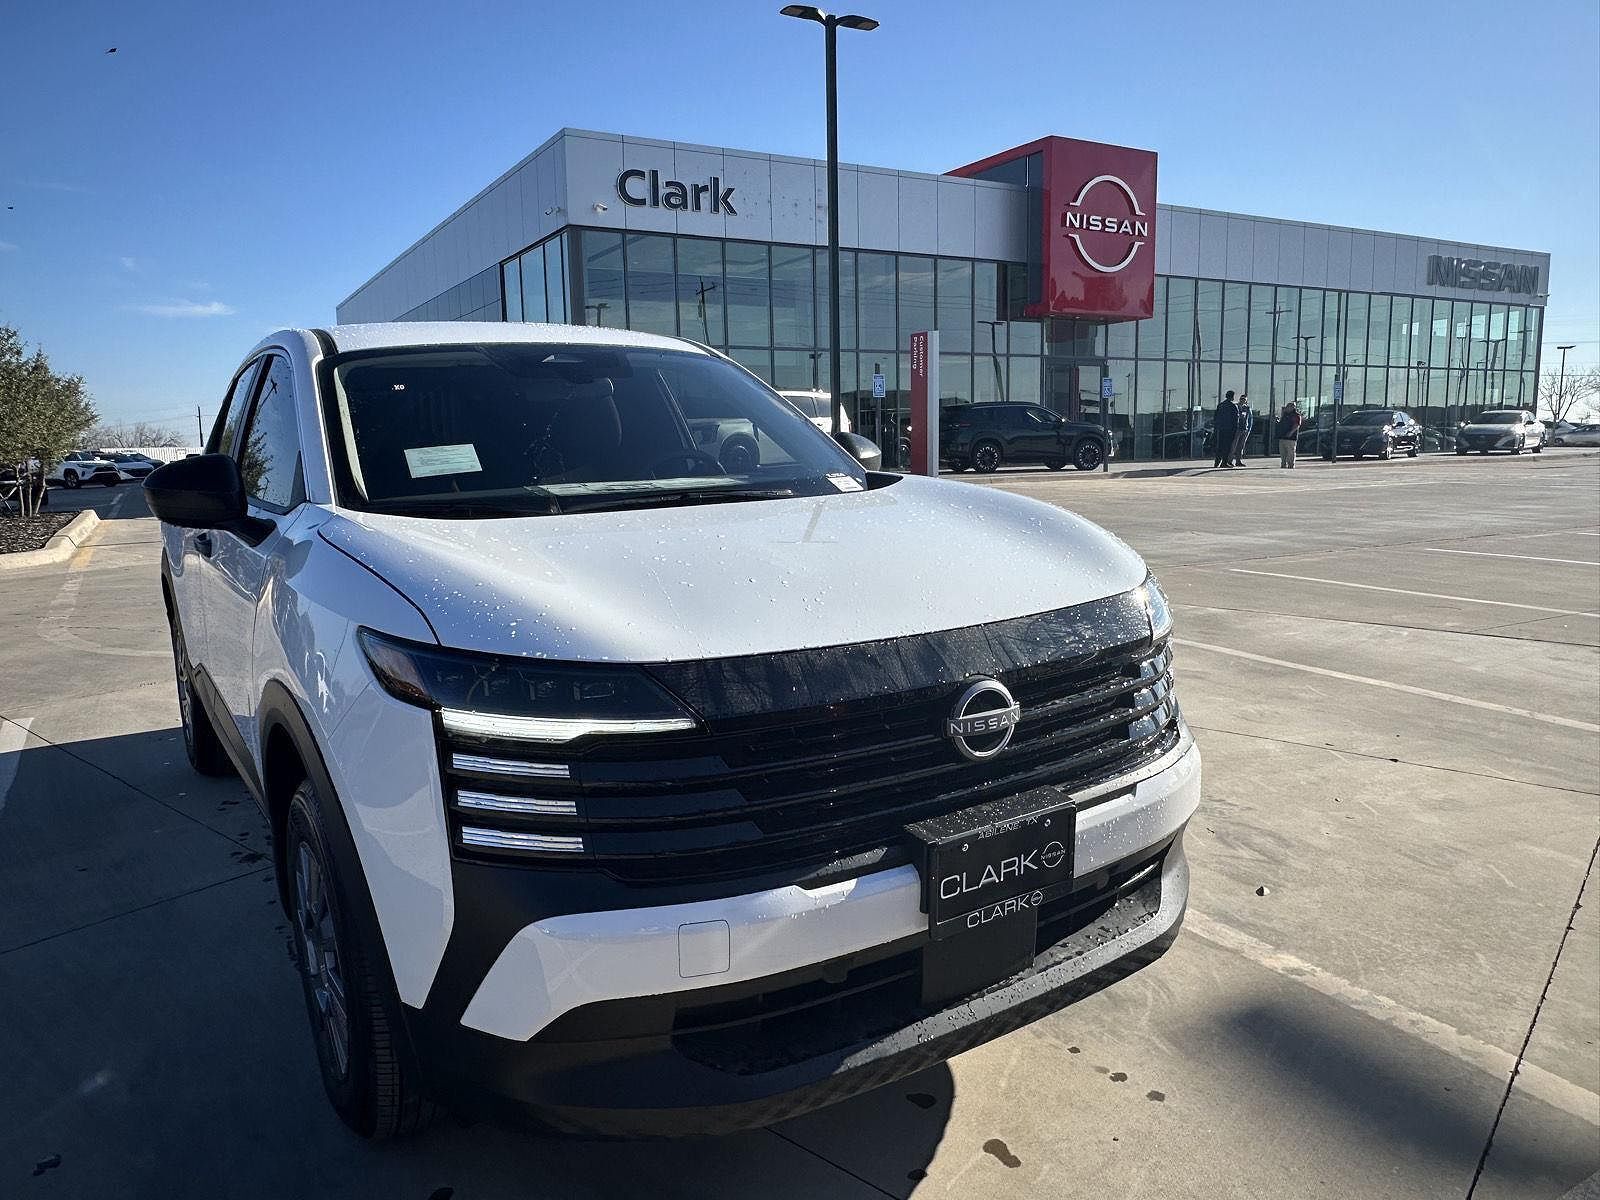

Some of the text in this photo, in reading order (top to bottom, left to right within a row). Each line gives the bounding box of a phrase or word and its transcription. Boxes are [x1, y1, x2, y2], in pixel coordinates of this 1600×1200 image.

[616, 168, 738, 216] Clark
[1065, 211, 1148, 237] NISSAN
[1427, 255, 1539, 294] NISSAN
[950, 711, 1020, 734] NISSAN
[940, 849, 1038, 900] CLARK
[966, 894, 1030, 928] CLARK
